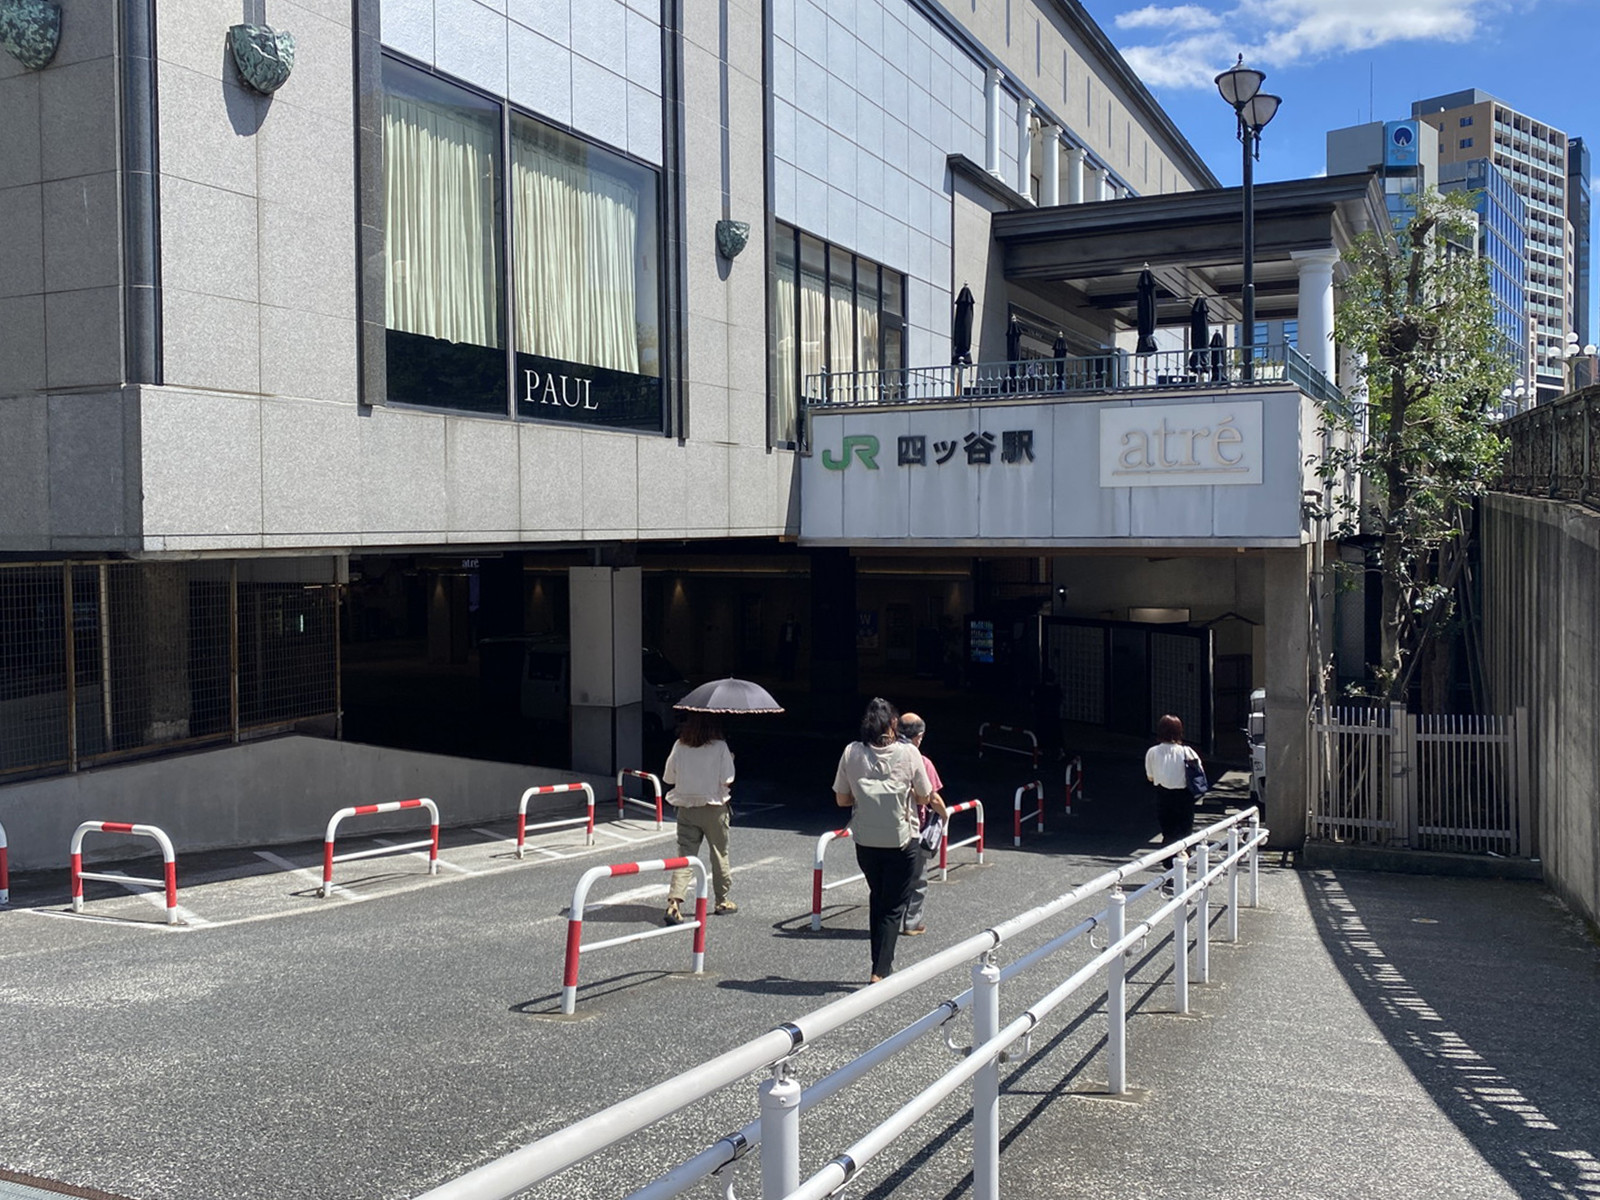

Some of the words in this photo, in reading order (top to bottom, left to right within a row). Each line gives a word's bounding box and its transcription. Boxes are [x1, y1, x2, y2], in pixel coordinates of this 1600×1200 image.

[524, 369, 599, 410] PAUL
[821, 434, 880, 471] JR
[896, 429, 1035, 467] 四ッ谷駅
[1118, 415, 1244, 467] atré
